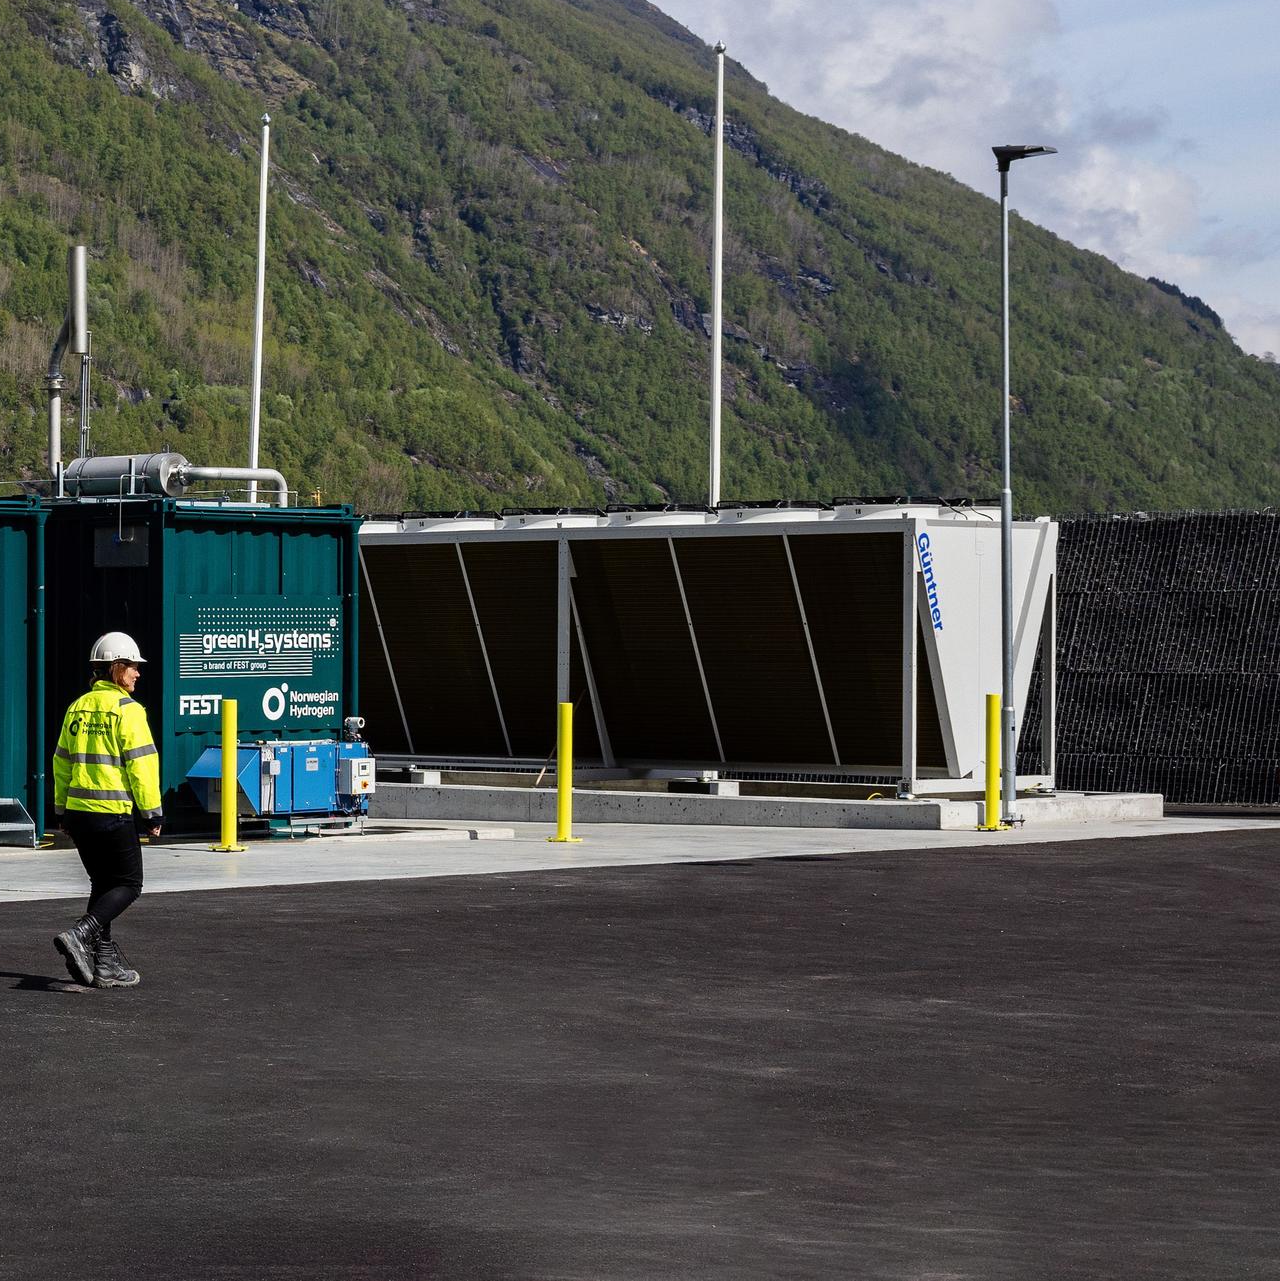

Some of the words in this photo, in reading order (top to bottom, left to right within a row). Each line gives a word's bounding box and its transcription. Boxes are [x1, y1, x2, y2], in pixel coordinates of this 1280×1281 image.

[918, 532, 943, 631] Güntner
[209, 662, 225, 670] brand
[226, 661, 232, 669] of
[233, 661, 249, 669] FEST
[250, 663, 266, 672] group
[290, 691, 338, 704] Norwegian
[179, 695, 222, 715] FEST
[290, 704, 334, 718] Hydrogen
